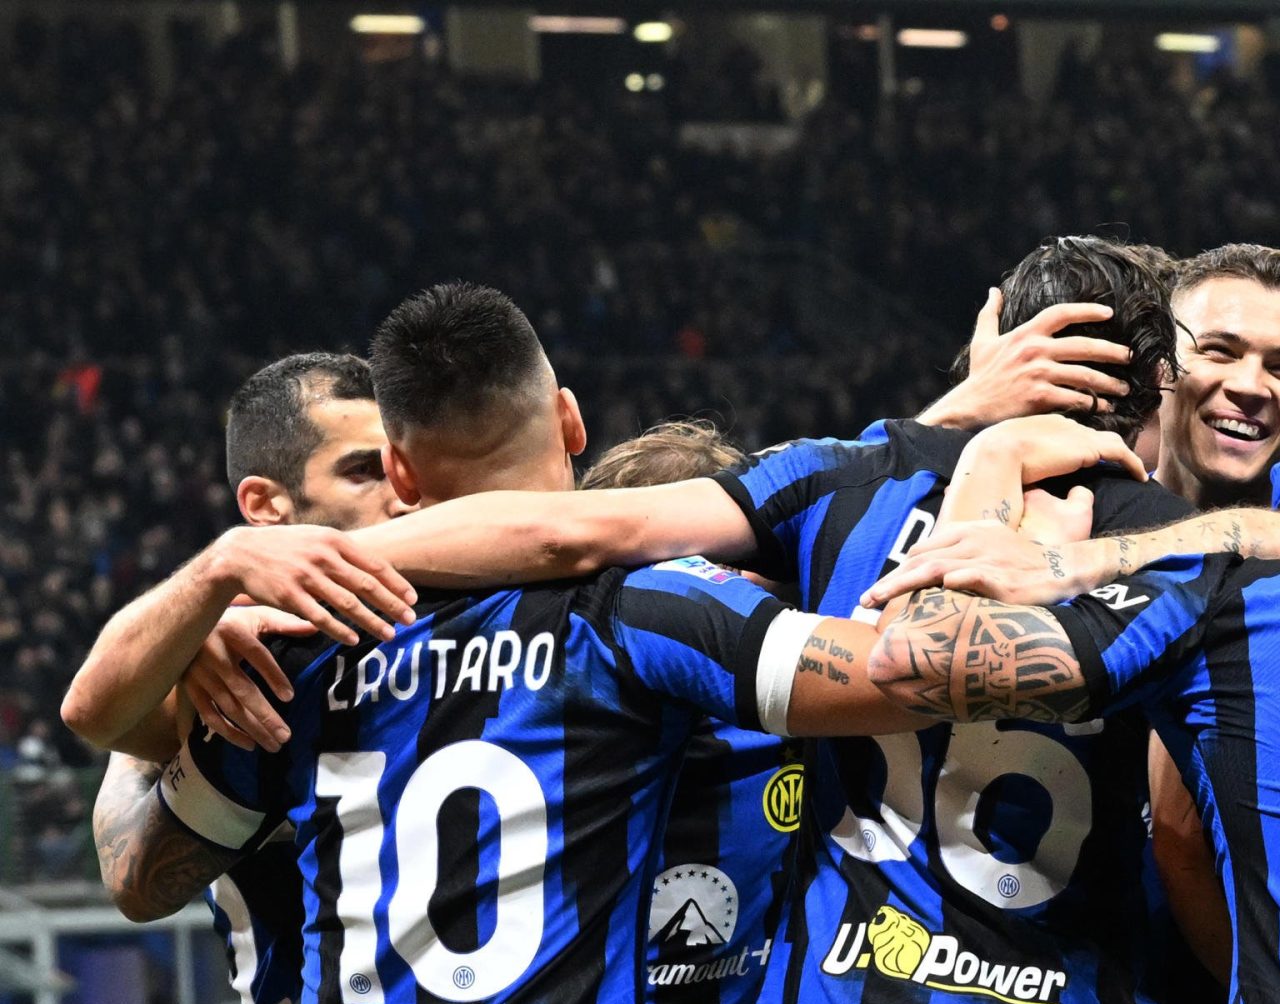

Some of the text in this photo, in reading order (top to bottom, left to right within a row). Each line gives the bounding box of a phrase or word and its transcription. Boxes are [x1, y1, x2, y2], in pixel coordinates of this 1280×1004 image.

[1088, 583, 1150, 610] ay
[327, 630, 555, 711] LAUTARO
[647, 939, 772, 985] amount+
